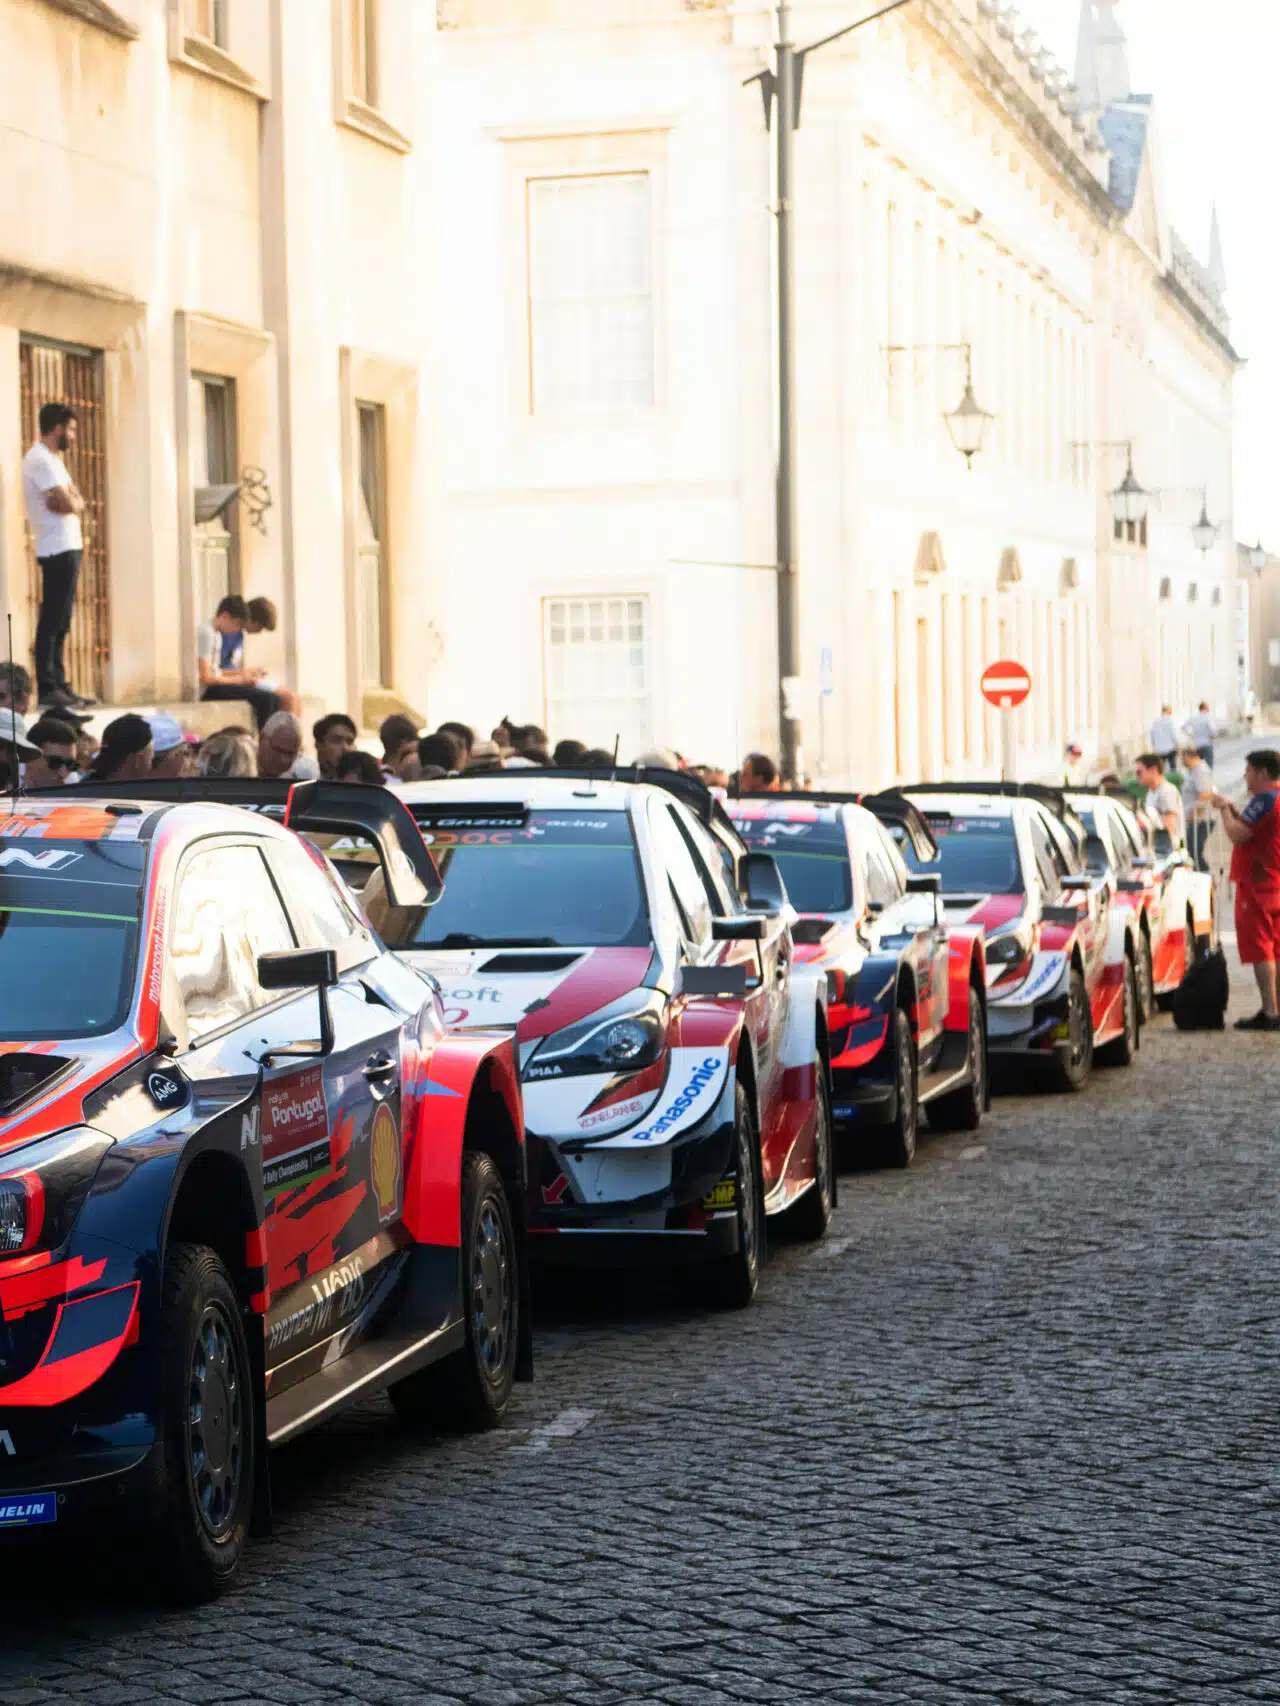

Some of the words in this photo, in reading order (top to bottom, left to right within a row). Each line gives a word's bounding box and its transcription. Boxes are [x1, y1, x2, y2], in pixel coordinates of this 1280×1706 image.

[437, 818, 522, 827] GAZOO
[529, 1065, 563, 1078] PIAA
[154, 1081, 179, 1102] AMG
[631, 1056, 722, 1141] Panasonic
[271, 1090, 324, 1128] Portugal
